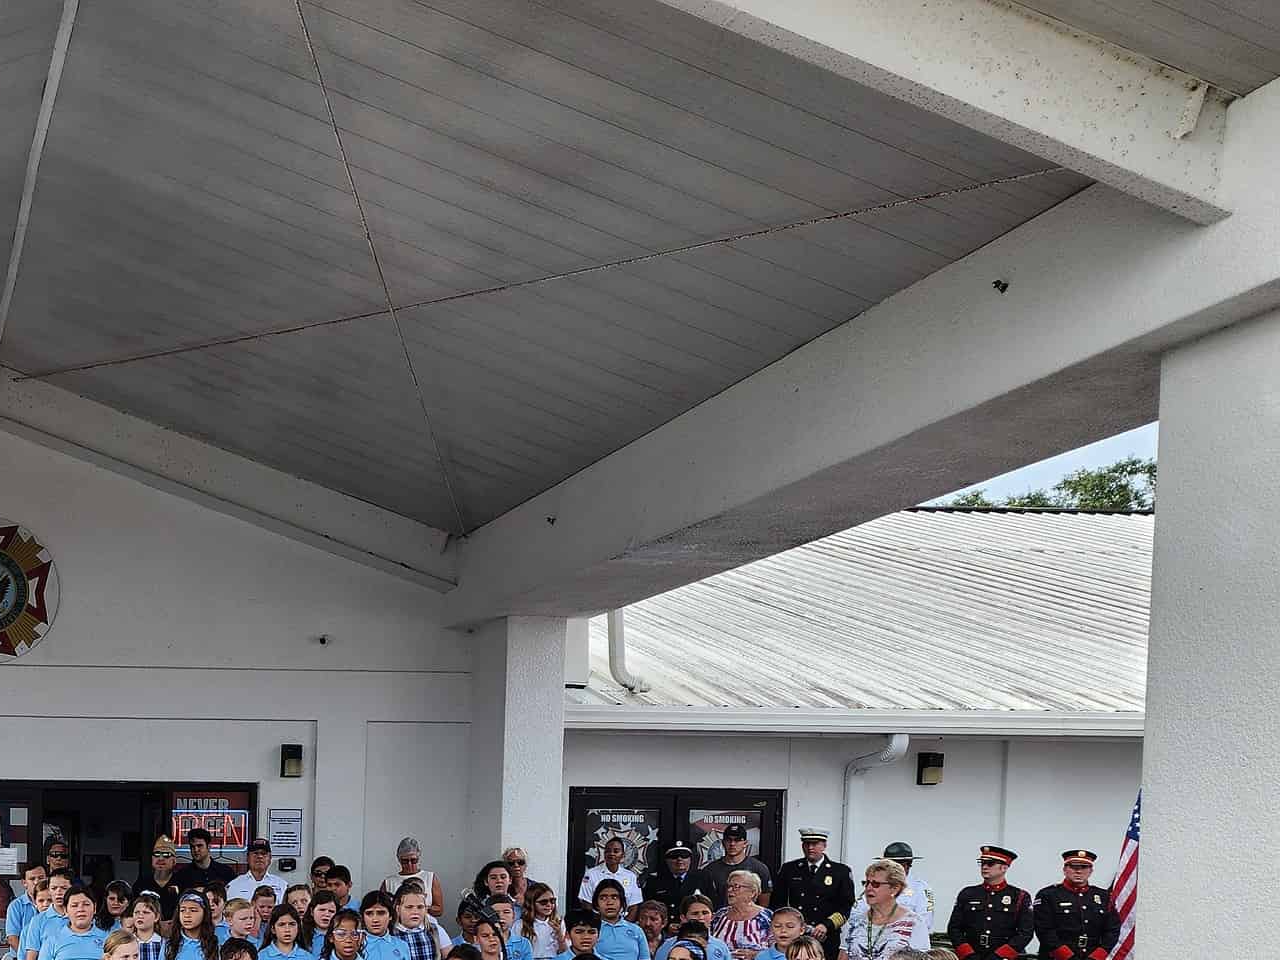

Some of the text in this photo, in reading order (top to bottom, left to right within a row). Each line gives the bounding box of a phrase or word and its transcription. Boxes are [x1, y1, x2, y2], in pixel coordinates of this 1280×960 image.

[176, 798, 229, 811] NEVER
[601, 814, 644, 823] NO SMOKING
[704, 816, 746, 824] NO SMOKING
